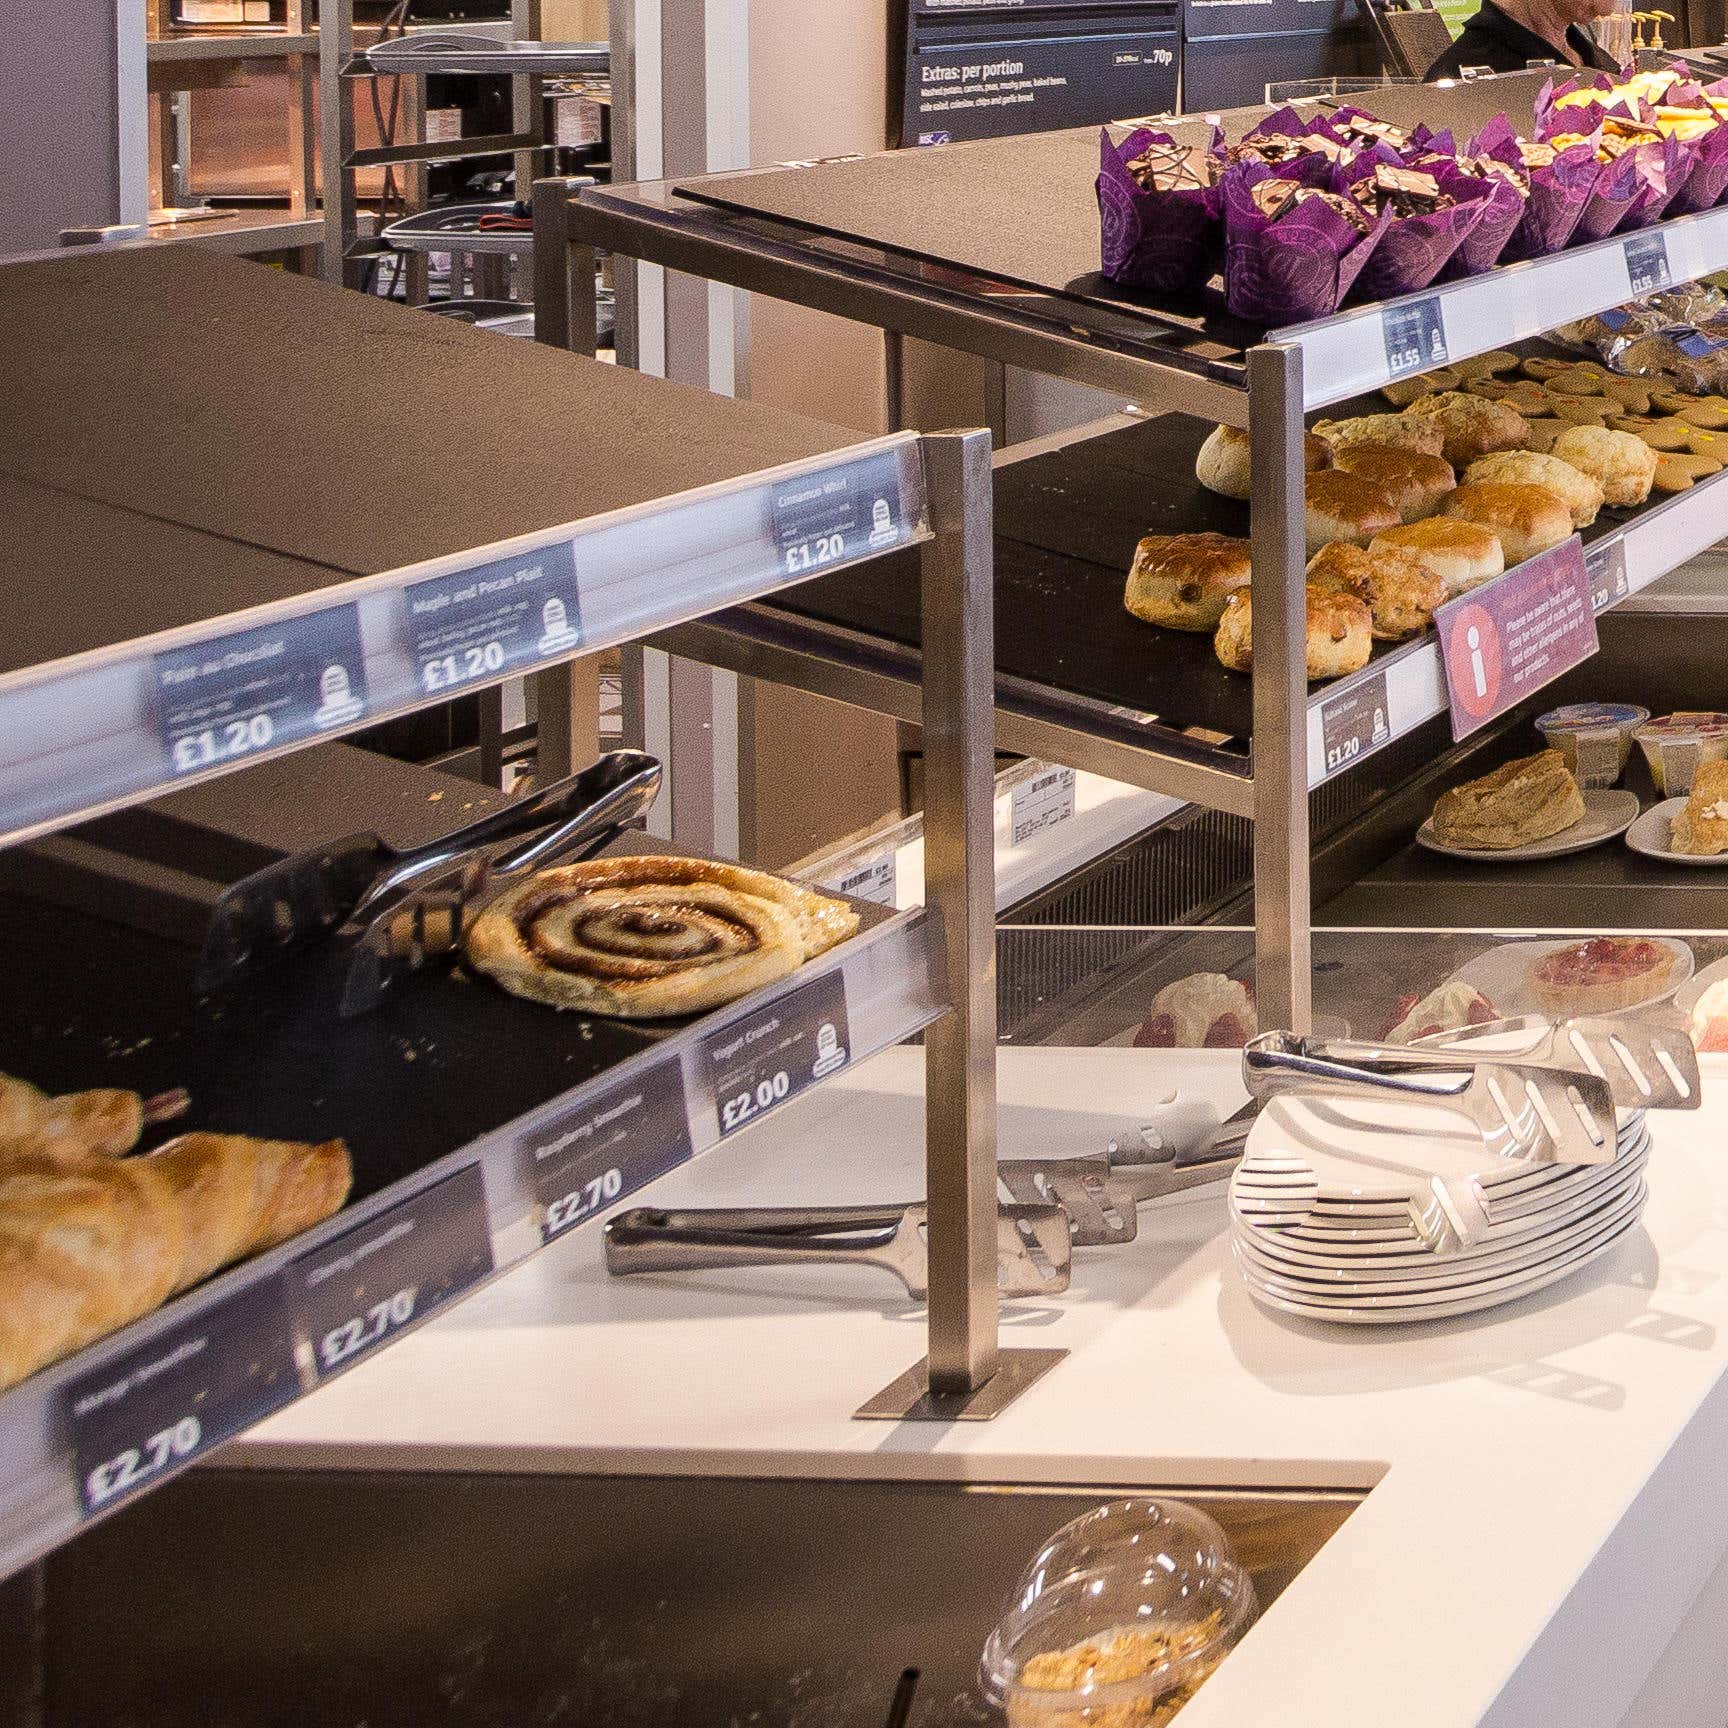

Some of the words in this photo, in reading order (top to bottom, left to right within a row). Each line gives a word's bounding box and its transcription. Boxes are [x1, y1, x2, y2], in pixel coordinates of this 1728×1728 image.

[962, 65, 982, 83] per
[983, 60, 1024, 79] portion
[1152, 49, 1173, 67] 70p
[1390, 347, 1421, 371] £1.55
[785, 533, 845, 573] £1.20
[423, 641, 505, 692] £1.20
[174, 713, 274, 772] £1.20
[1327, 735, 1360, 770] £1.20
[722, 1070, 790, 1130] £2.00
[546, 1167, 623, 1235] £2.70
[321, 1285, 419, 1369] £2.70
[86, 1414, 202, 1508] £2.70
